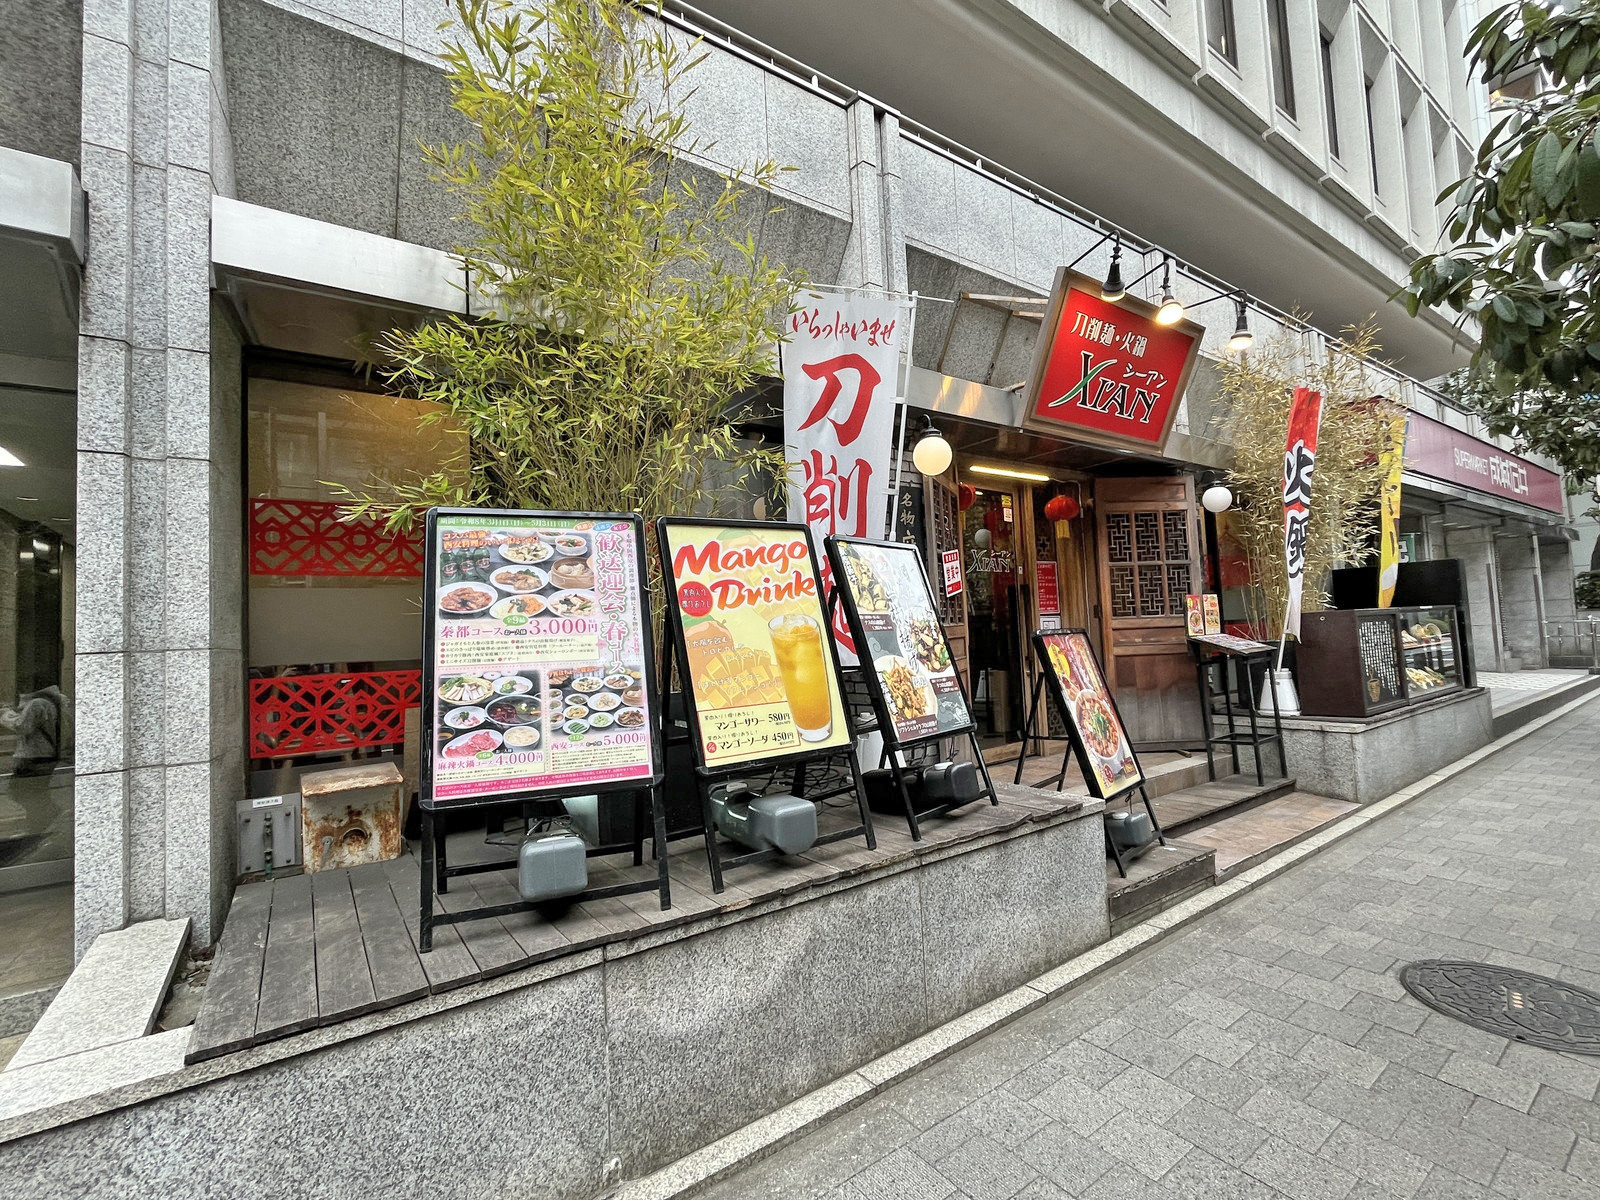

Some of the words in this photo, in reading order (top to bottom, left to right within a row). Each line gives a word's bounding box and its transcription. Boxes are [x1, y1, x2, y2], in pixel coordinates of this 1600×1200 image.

[792, 308, 896, 347] いらっしゃいませ
[1071, 311, 1149, 358] 刀削麺・火鍋
[1122, 362, 1168, 389] シーアン
[1453, 447, 1489, 476] SUPERMARKET
[1488, 455, 1529, 496] 成城石井
[673, 540, 808, 579] Mango
[990, 550, 1011, 558] シーアン
[598, 533, 627, 673] 歓送迎会・春コース
[709, 570, 816, 611] Drink
[441, 625, 503, 638] 秦都コース
[529, 618, 598, 636] 3,000円
[714, 717, 766, 730] マンゴーサワー
[768, 712, 791, 723] 580円
[718, 735, 769, 750] マンゴーソーダ
[772, 732, 794, 742] 450円
